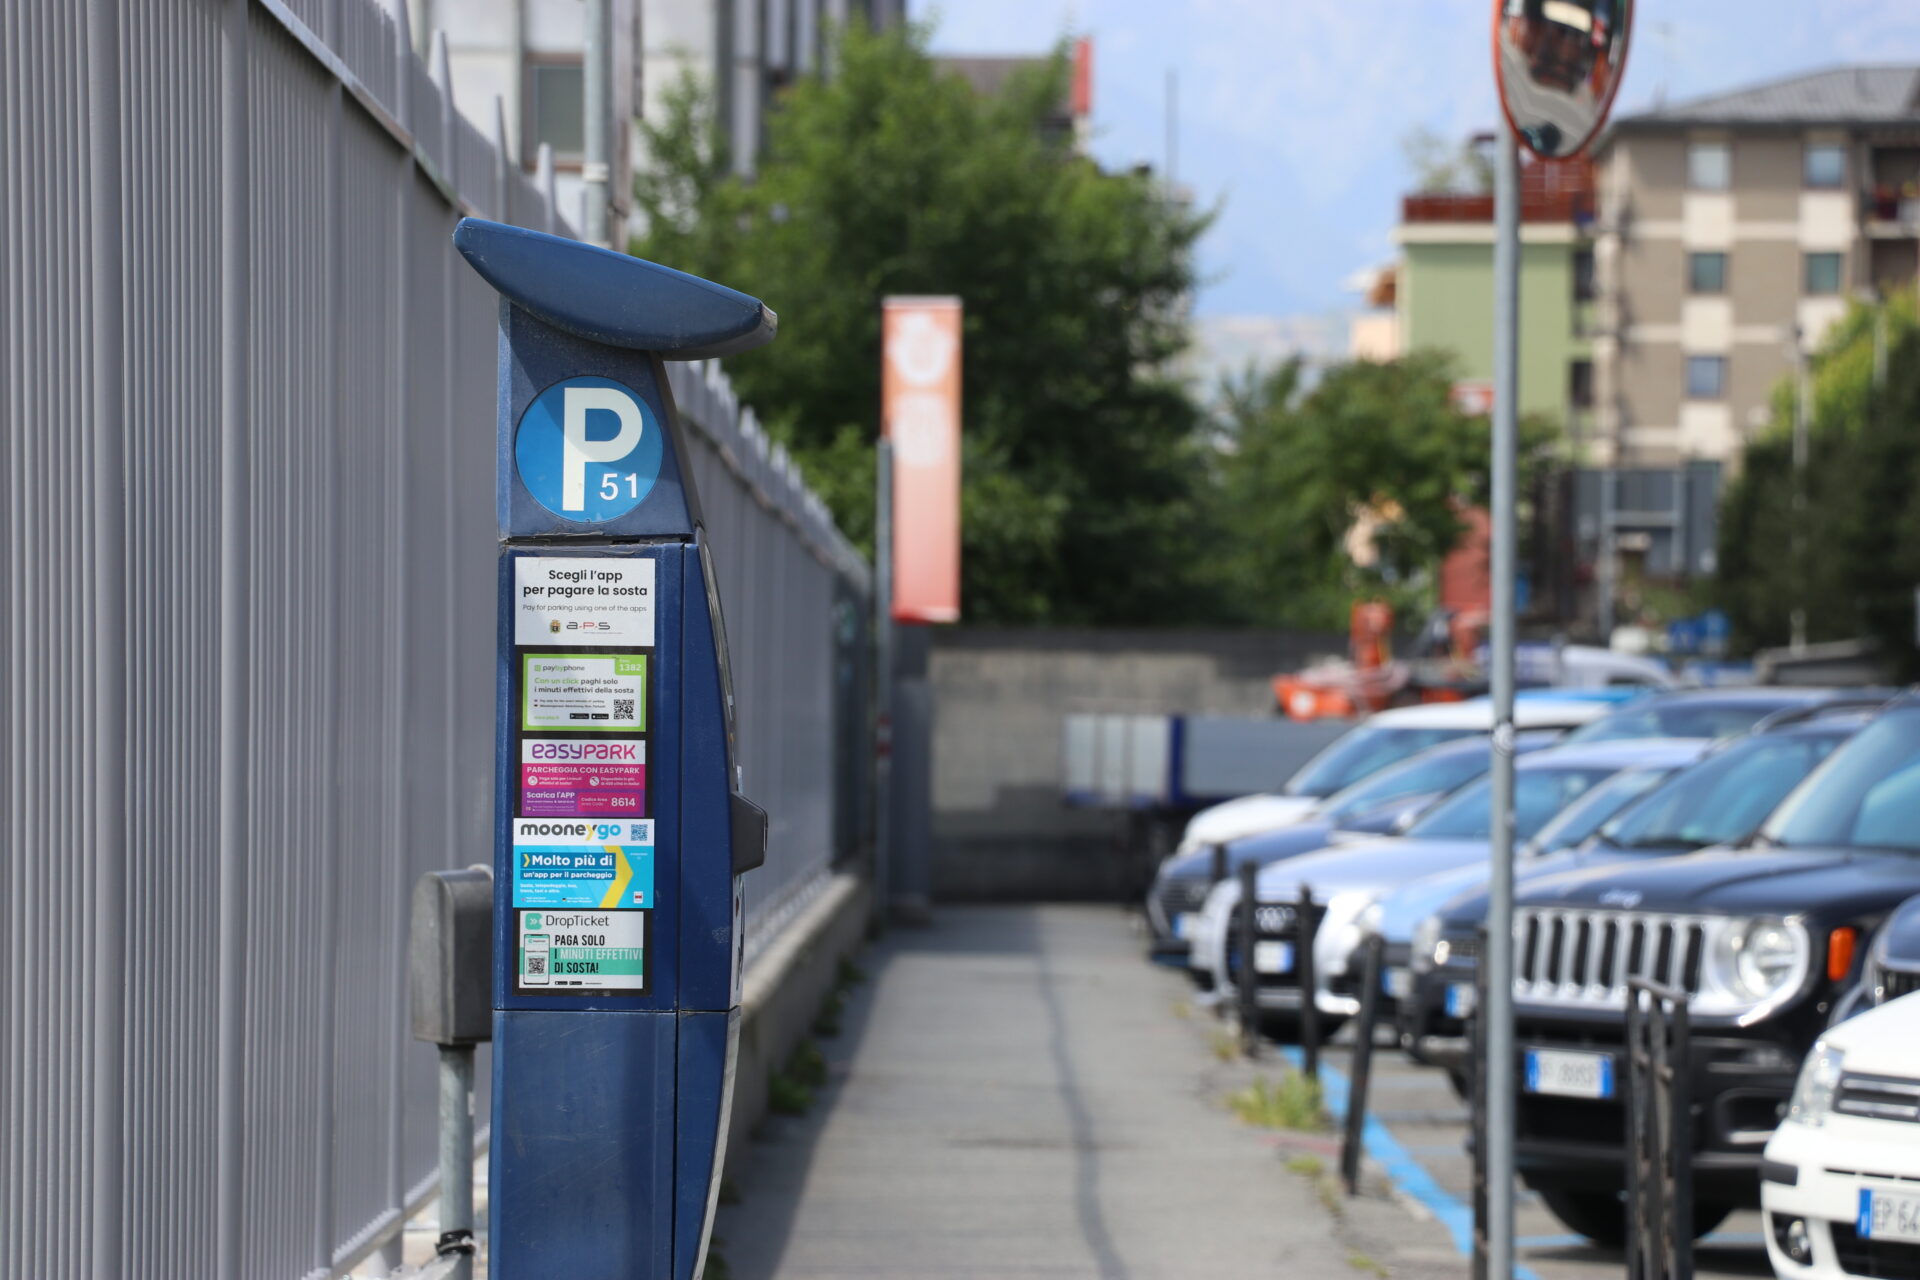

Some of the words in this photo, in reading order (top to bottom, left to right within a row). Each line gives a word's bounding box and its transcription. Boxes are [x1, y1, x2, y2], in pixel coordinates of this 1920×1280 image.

[562, 387, 643, 511] P
[600, 472, 637, 501] 51
[548, 569, 587, 583] Scegli
[523, 586, 544, 598] per
[547, 586, 594, 598] pagare
[598, 585, 609, 596] la
[612, 586, 648, 596] sosta
[547, 604, 573, 612] parking
[542, 664, 585, 672] paybyphone
[526, 766, 578, 774] PARCHEGGIA
[526, 791, 555, 799] Scarica
[611, 797, 636, 807] 8614
[520, 824, 621, 841] mooneygo
[531, 855, 571, 866] Molto
[574, 854, 596, 867] più
[599, 855, 613, 866] di
[523, 871, 548, 879] un'app
[570, 871, 612, 879] parcheggio
[545, 915, 609, 928] DropTicket
[554, 935, 579, 946] PAGA
[581, 935, 605, 946] SOLO
[554, 948, 558, 959] I
[560, 948, 593, 960] MINUTI
[596, 949, 643, 960] EFFETTIVI
[554, 962, 563, 973] DI
[566, 962, 599, 973] SOSTA!
